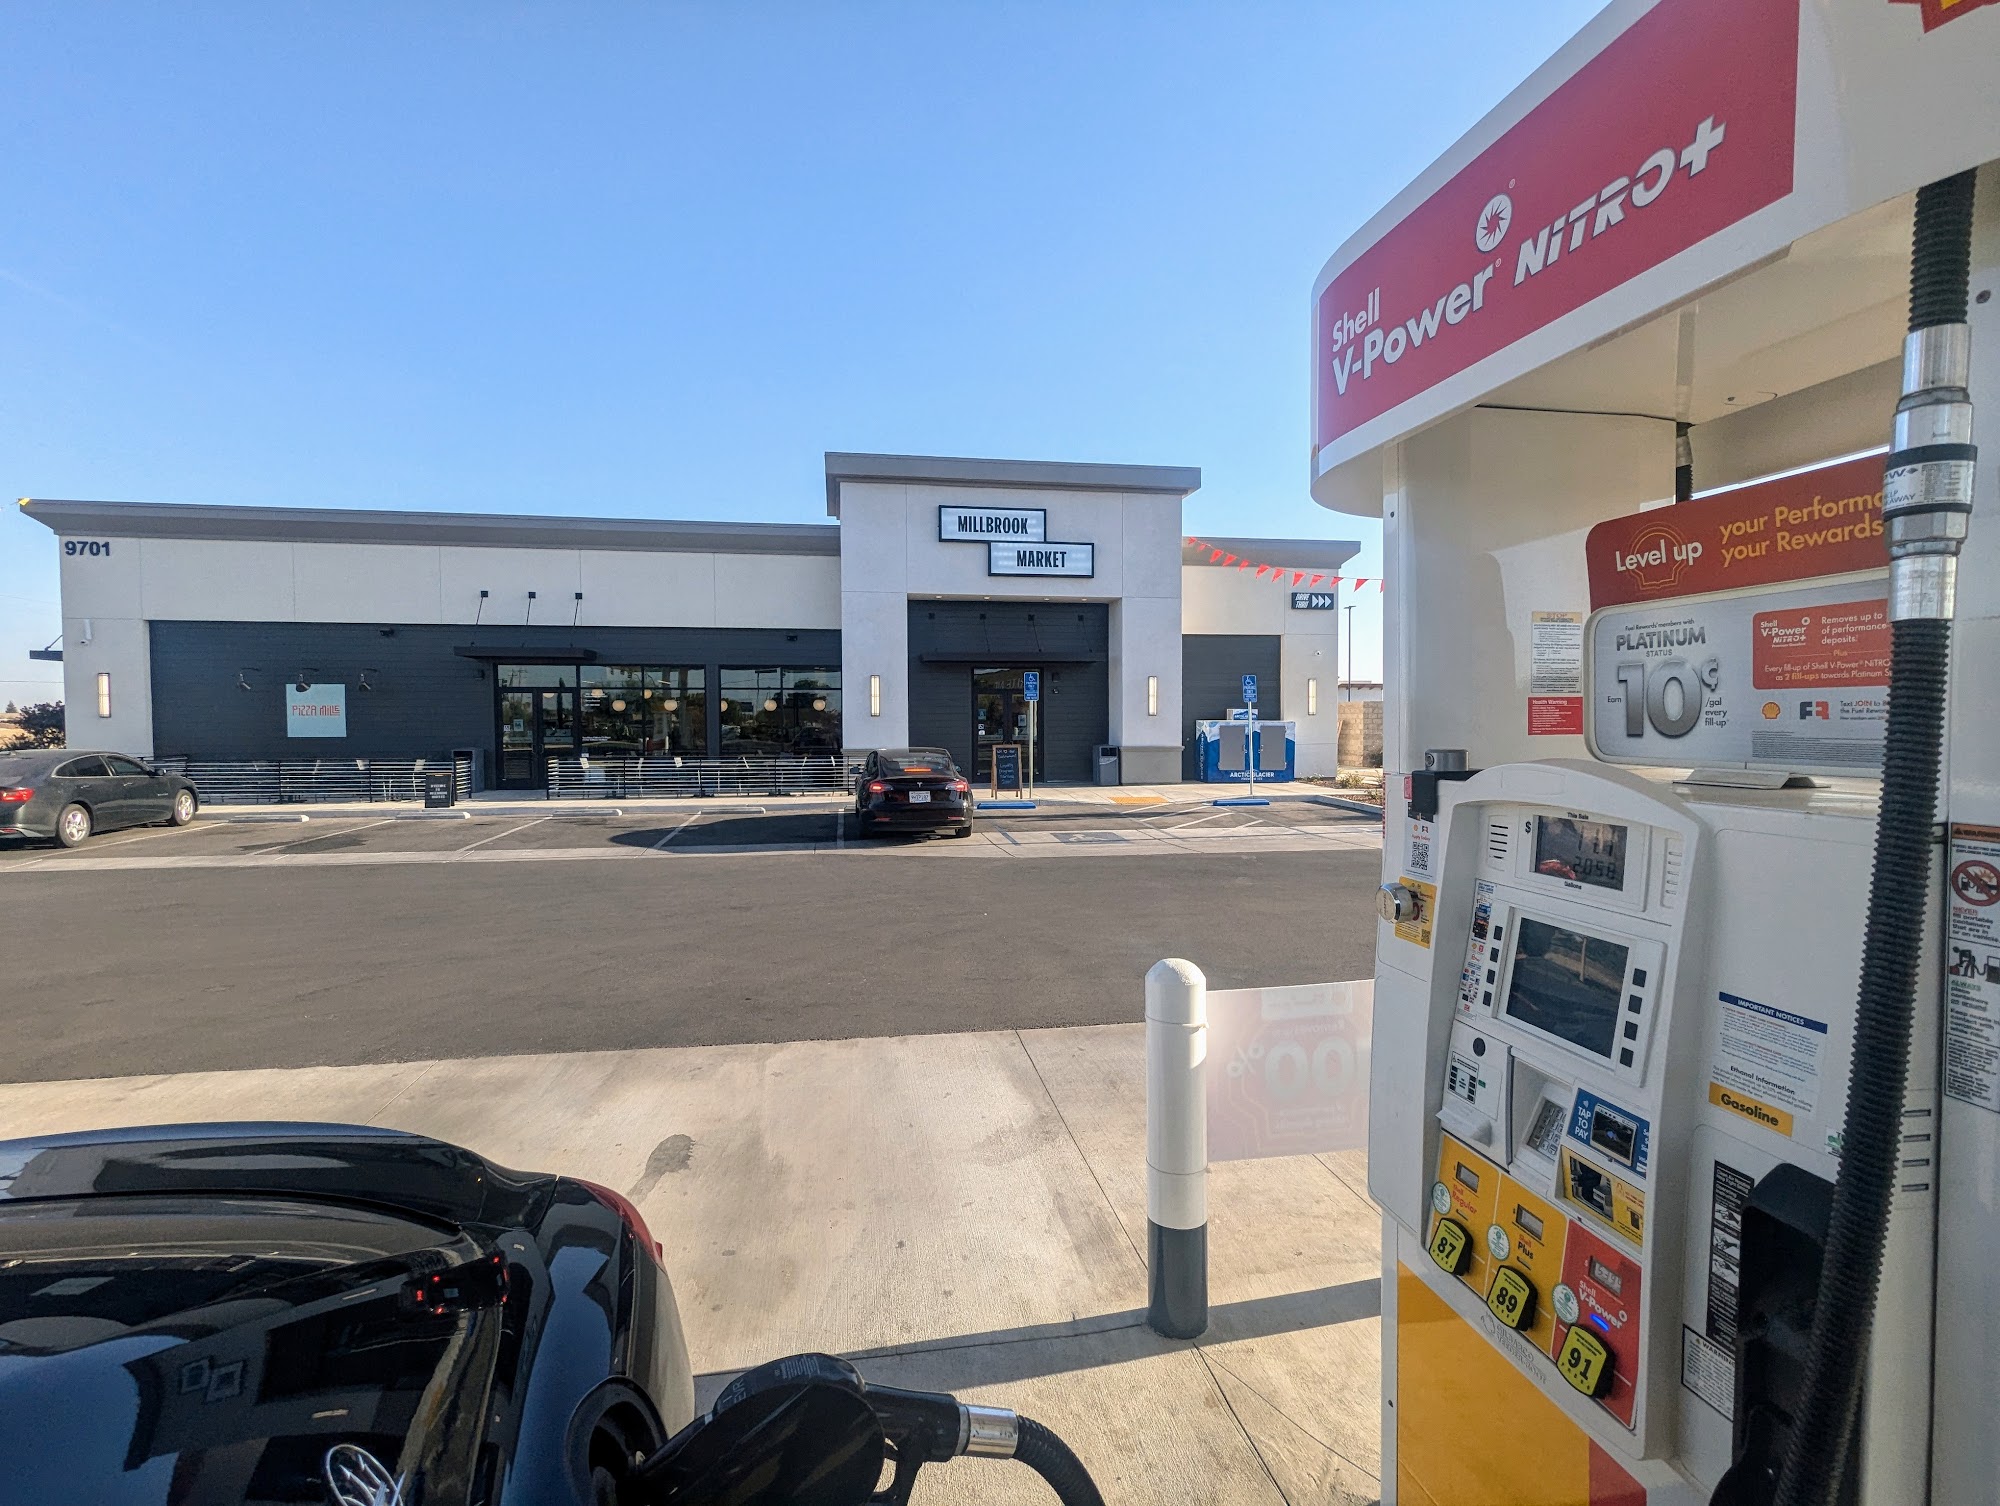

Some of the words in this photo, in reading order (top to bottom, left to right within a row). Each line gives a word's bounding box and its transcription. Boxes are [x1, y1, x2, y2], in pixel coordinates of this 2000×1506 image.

[1332, 287, 1380, 352] Shell
[1332, 263, 1494, 396] V-Power
[957, 515, 1029, 535] MILLBROOK
[1719, 514, 1769, 545] your
[1775, 491, 1884, 528] Performa
[64, 540, 110, 556] 9701
[1721, 540, 1770, 568] your
[1776, 512, 1884, 552] Rewards
[1016, 550, 1067, 568] MARKET
[1615, 539, 1667, 572] Level
[1673, 541, 1703, 566] up
[1657, 620, 1682, 628] members
[1760, 620, 1778, 629] Shell
[1821, 615, 1858, 625] Removes
[1860, 614, 1872, 623] up
[1873, 612, 1883, 620] to
[1616, 626, 1707, 652] PLATINUM
[1761, 626, 1807, 638] V-Power
[1821, 626, 1831, 635] of
[1645, 649, 1673, 658] STATUS
[1765, 664, 1783, 673] Every
[1802, 662, 1811, 670] of
[1812, 661, 1828, 669] Shell
[1851, 669, 1883, 678] Platinum
[1705, 697, 1722, 708] /gal
[1705, 710, 1728, 718] every
[1525, 821, 1532, 834] $
[1738, 999, 1775, 1016] IMPORTANT
[1775, 1011, 1805, 1025] NOTICES
[1730, 1065, 1755, 1080] Ethanol
[1755, 1075, 1796, 1095] Information
[1577, 1106, 1592, 1119] TAP
[1720, 1093, 1780, 1127] Gasoline
[1577, 1118, 1589, 1129] TO
[1574, 1127, 1589, 1141] PAY
[1452, 1191, 1477, 1215] Regular
[1437, 1236, 1457, 1260] 87
[1517, 1241, 1534, 1260] Plus
[1579, 1280, 1596, 1298] Shell
[1496, 1286, 1518, 1313] 89
[1578, 1288, 1623, 1329] V-Power
[1567, 1347, 1593, 1381] 91
